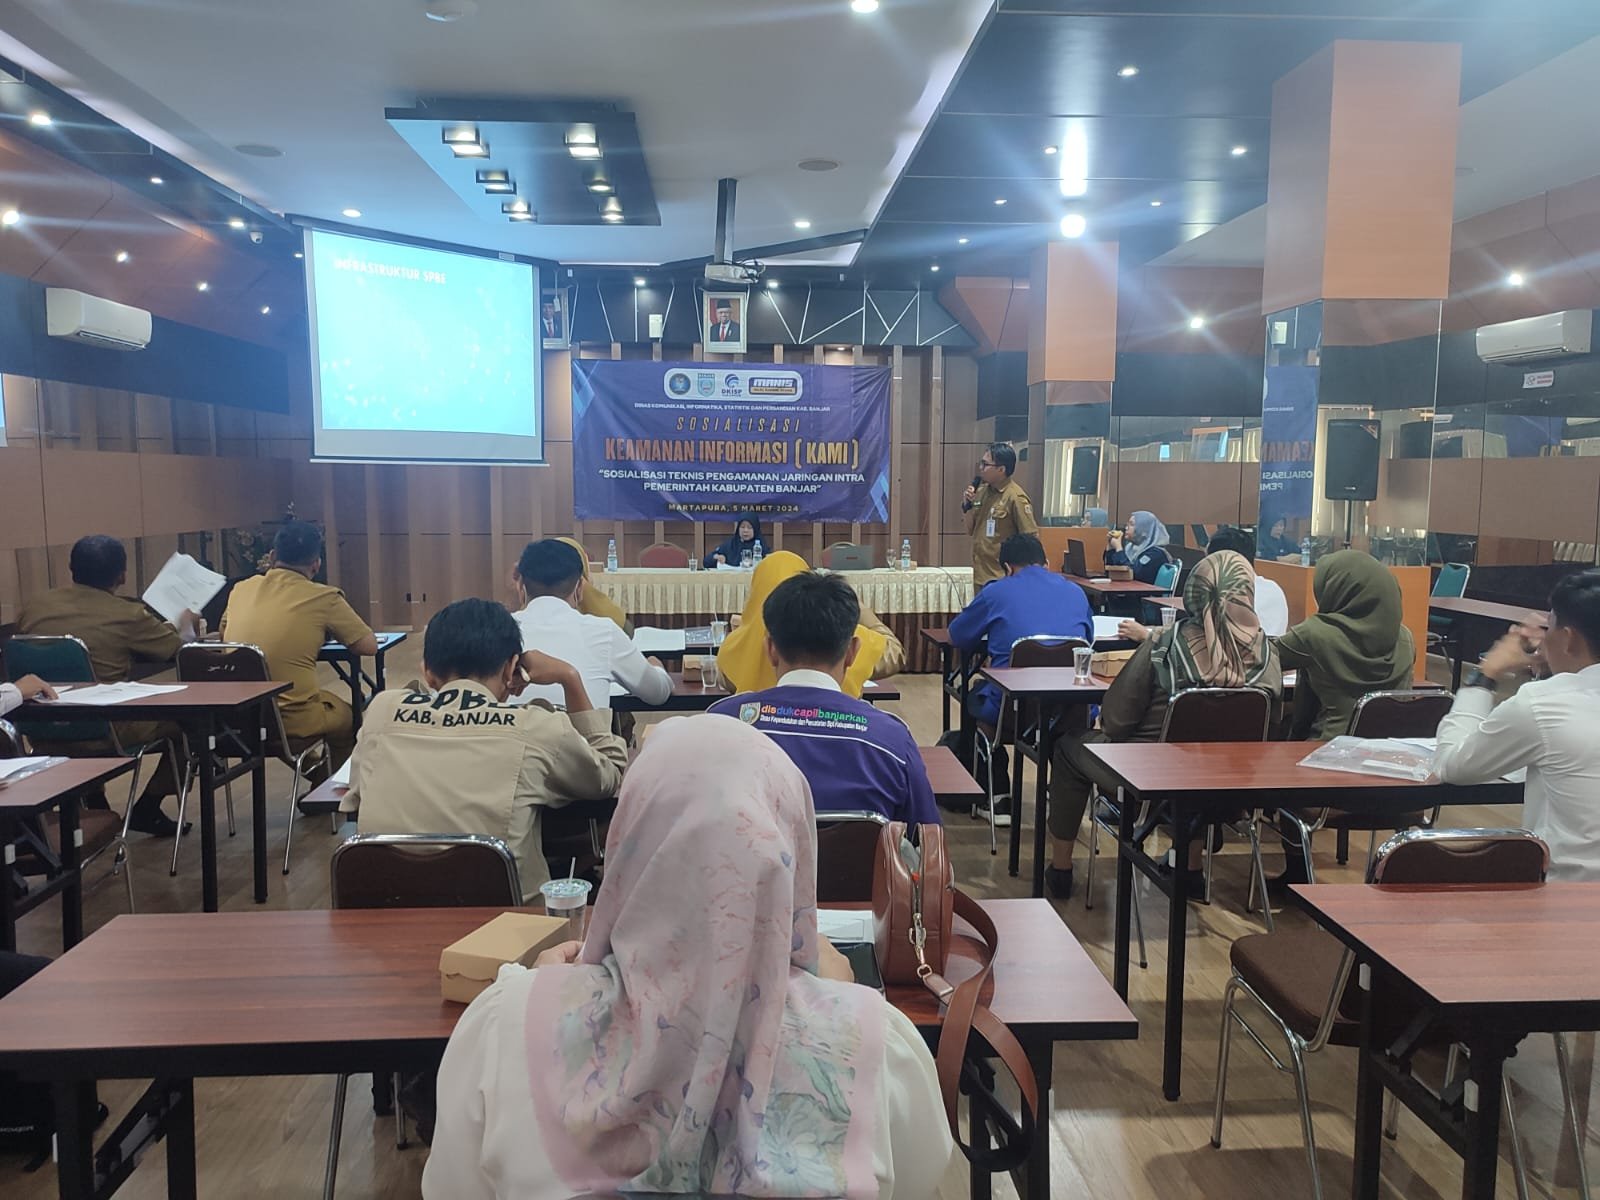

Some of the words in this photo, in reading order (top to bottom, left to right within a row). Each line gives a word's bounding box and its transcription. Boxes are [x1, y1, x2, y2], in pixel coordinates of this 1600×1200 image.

[676, 416, 801, 433] SOSIALISASI
[605, 438, 696, 463] KEAMANAN
[699, 440, 789, 464] INFORMASI
[667, 471, 705, 480] TEKNIS
[705, 472, 780, 481] PENGAMANAN
[780, 472, 834, 482] JARINGAN
[834, 473, 866, 483] INTRA
[643, 482, 710, 493] PEMERINTAH
[711, 483, 775, 493] KABUPATEN
[668, 503, 730, 513] MARTAPURA,
[741, 504, 774, 513] MARET
[776, 504, 800, 512] 2024
[393, 708, 436, 726] KAB.
[442, 711, 516, 727] BANJAR
[761, 704, 868, 724] disdukcapilbanjarkab
